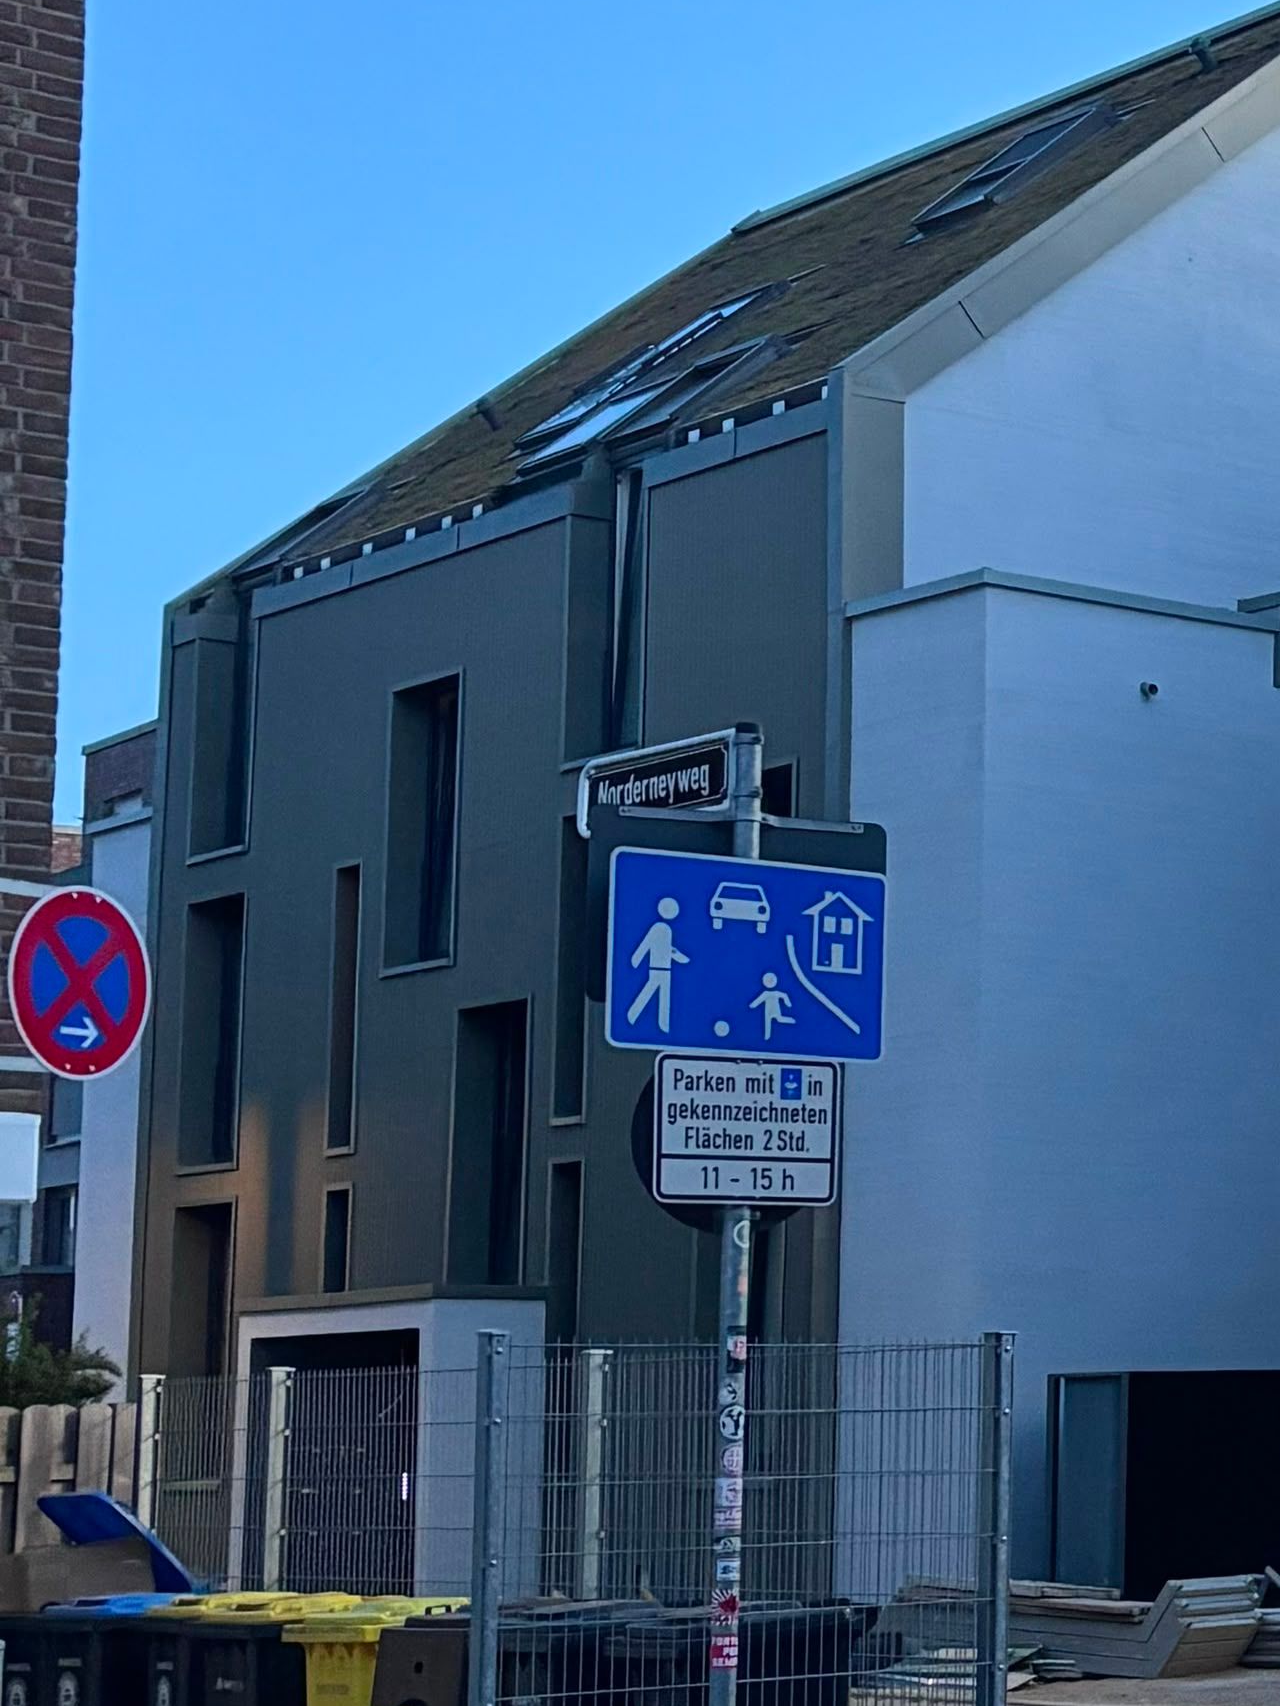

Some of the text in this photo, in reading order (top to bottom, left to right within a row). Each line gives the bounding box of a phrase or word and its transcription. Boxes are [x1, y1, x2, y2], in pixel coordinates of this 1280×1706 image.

[597, 763, 711, 806] Norderneyweg
[673, 1068, 823, 1096] Parken mit in
[667, 1097, 828, 1125] gekennzeichneten
[684, 1126, 811, 1153] Flächen 2 Std.
[701, 1166, 720, 1190] 11
[750, 1167, 773, 1191] 15
[782, 1168, 795, 1191] h
